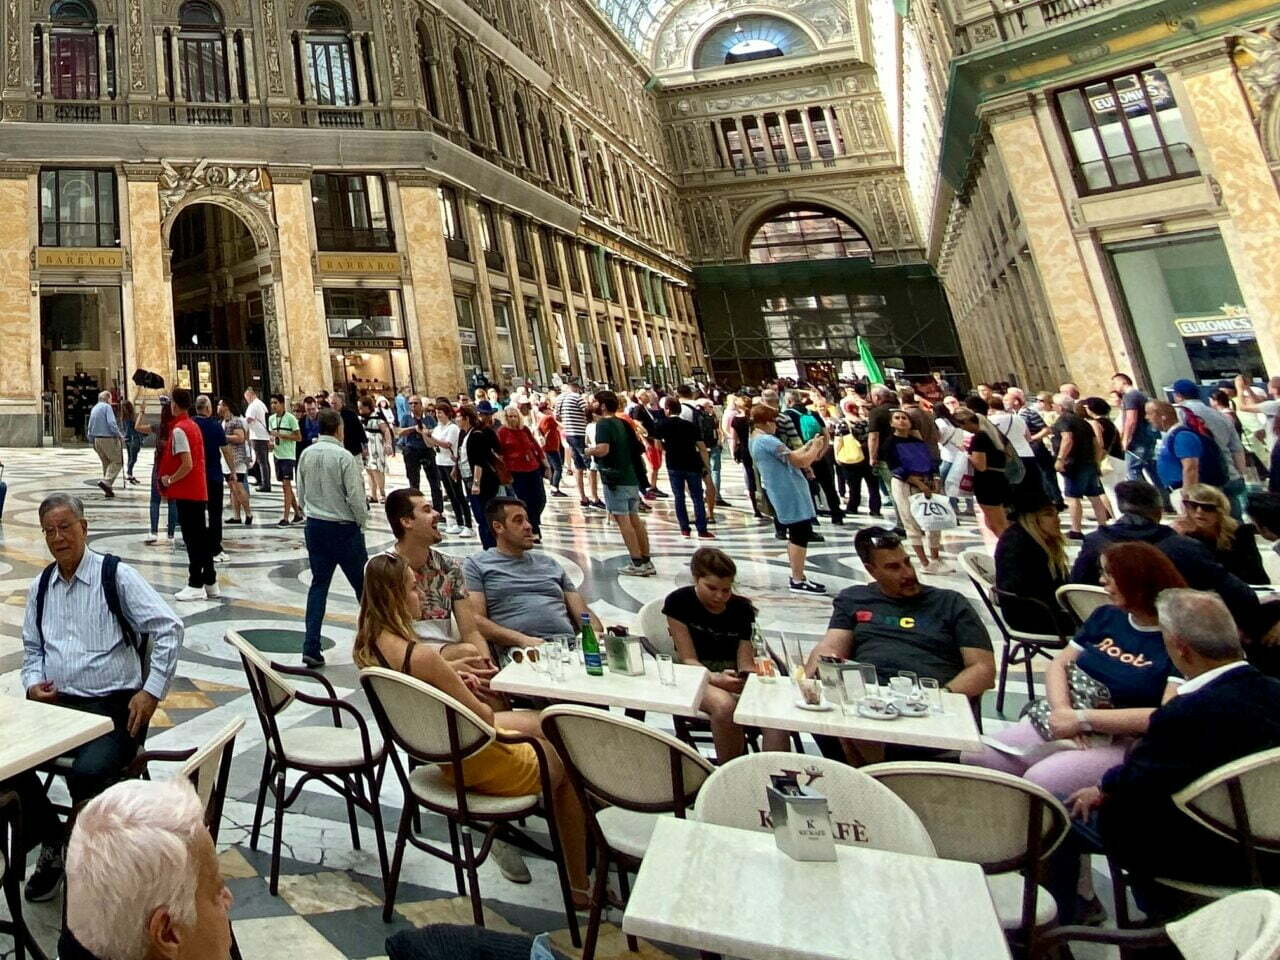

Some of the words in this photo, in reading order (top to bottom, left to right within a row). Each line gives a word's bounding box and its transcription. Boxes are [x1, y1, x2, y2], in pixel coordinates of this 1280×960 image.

[1094, 85, 1159, 111] EUONIS
[46, 255, 116, 265] BARBARO
[326, 260, 394, 270] BARBARO
[1181, 318, 1252, 333] EURONICS
